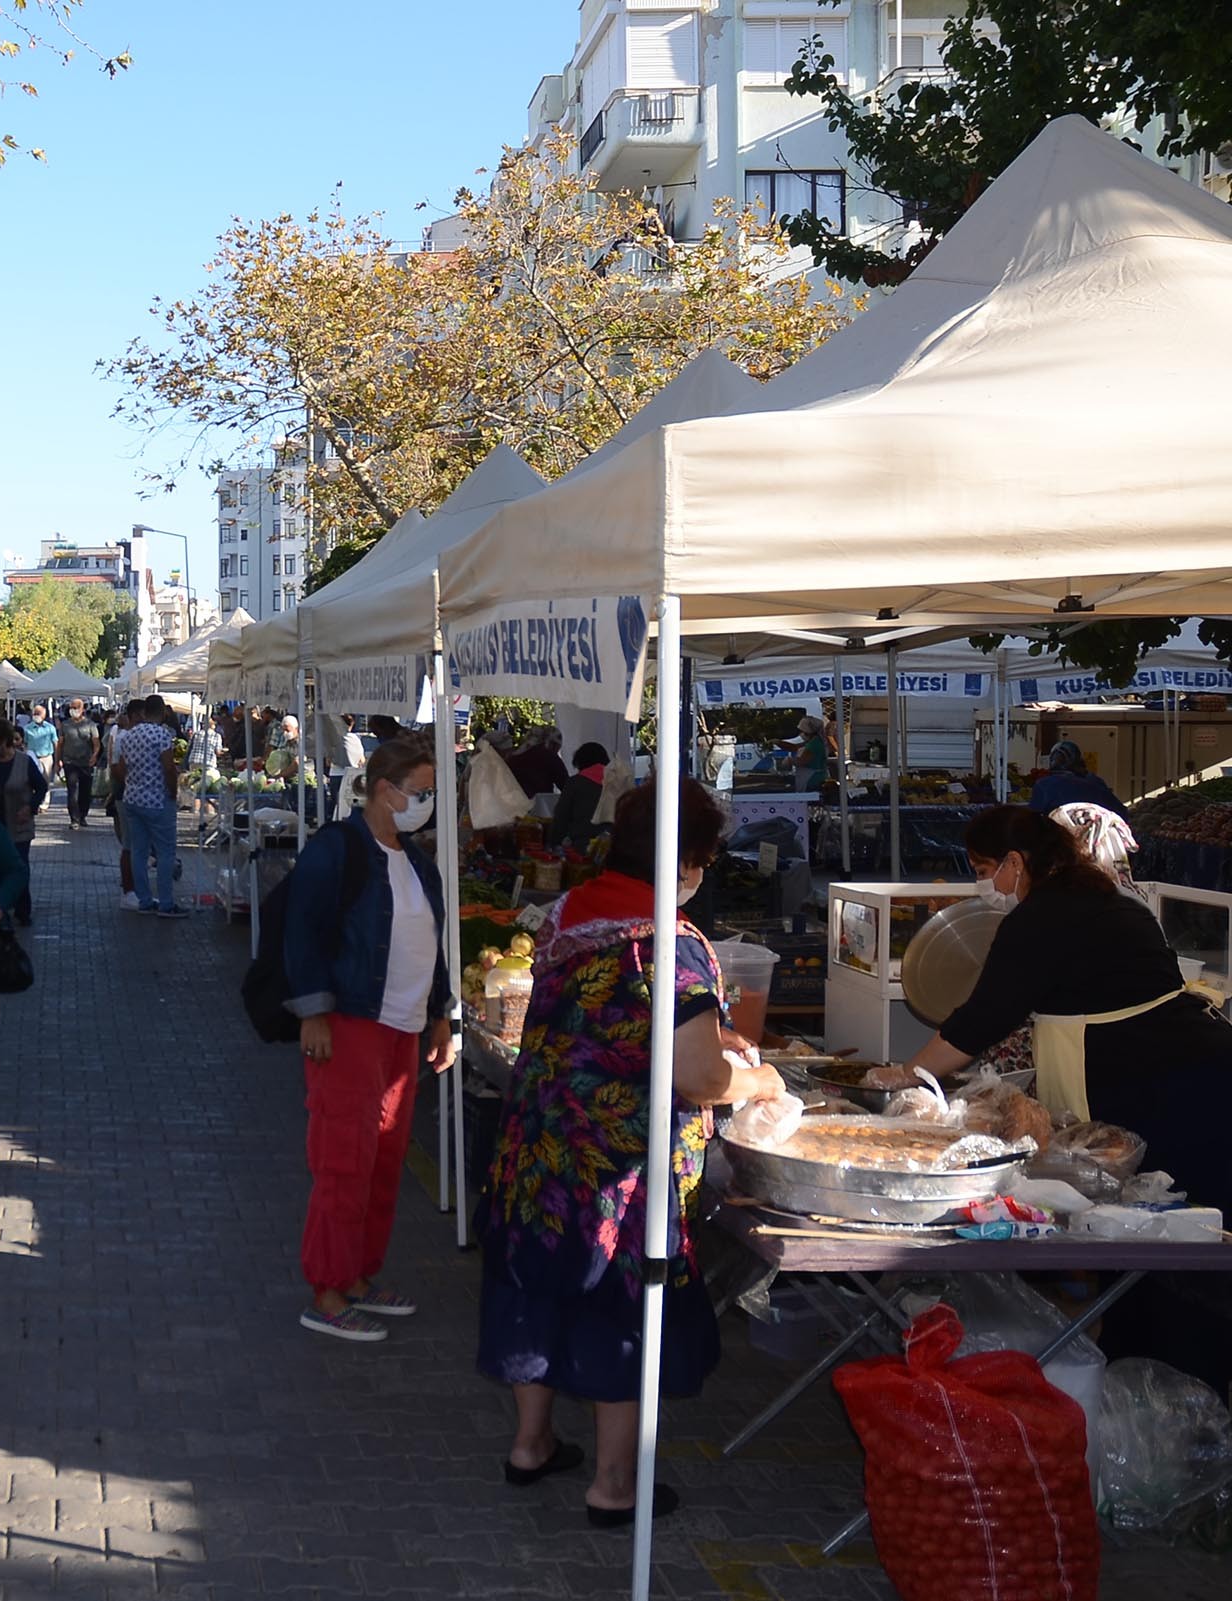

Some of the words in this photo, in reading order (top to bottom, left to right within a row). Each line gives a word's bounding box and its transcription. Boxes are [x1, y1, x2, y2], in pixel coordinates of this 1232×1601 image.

[501, 598, 603, 683] BELEDİYESİ
[740, 676, 836, 698] KUŞADASI
[842, 672, 947, 692] BELEİYESİ
[1055, 671, 1157, 695] KUŞAASI
